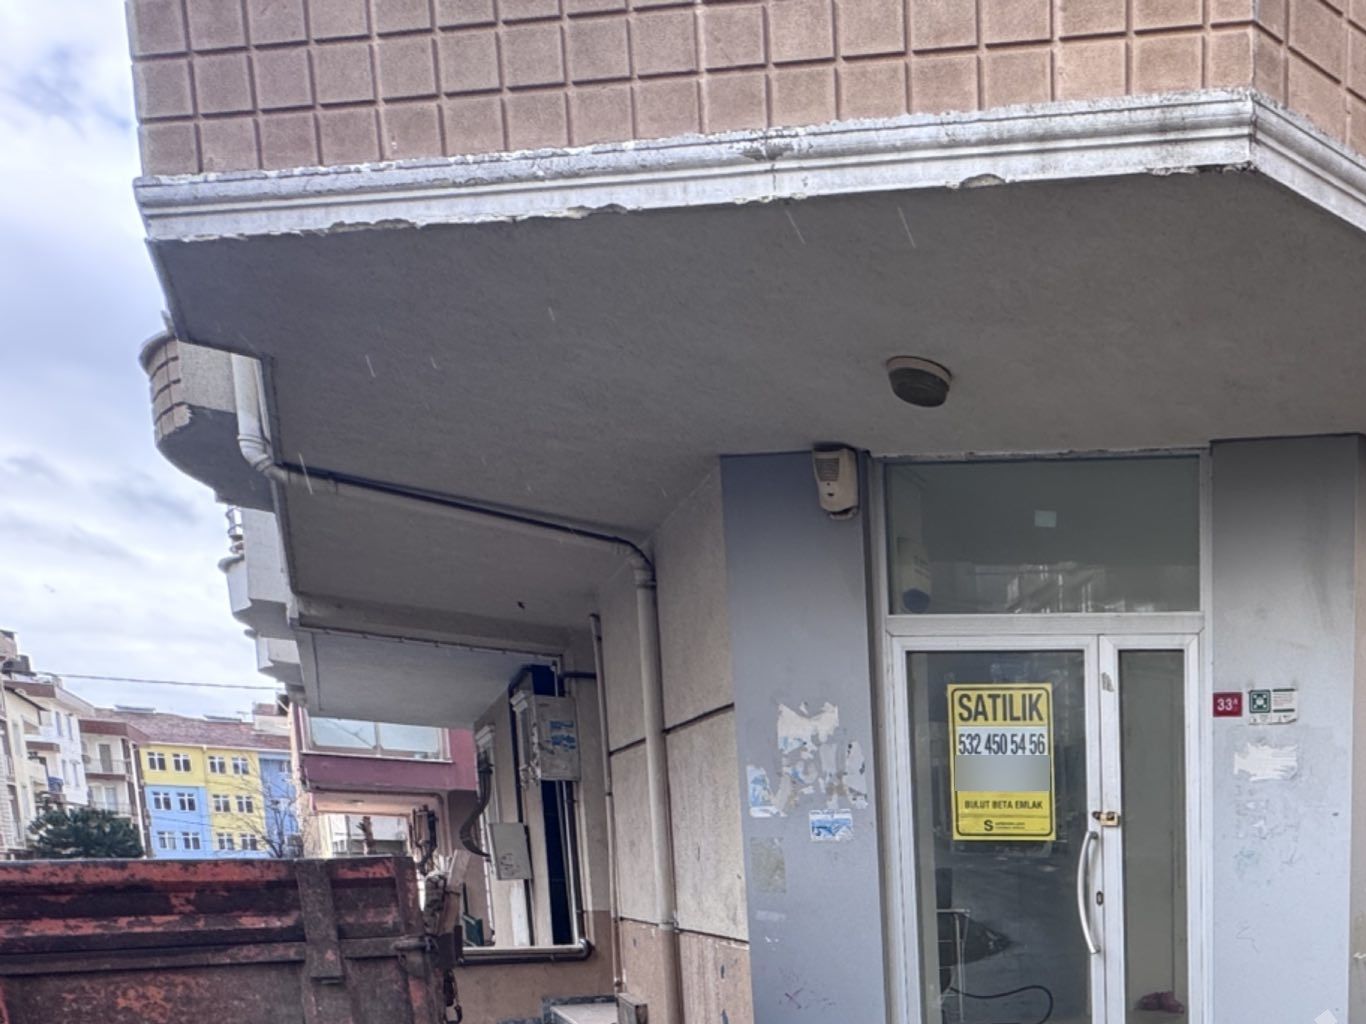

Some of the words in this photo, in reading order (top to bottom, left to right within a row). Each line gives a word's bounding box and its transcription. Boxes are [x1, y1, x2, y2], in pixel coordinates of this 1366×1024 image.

[958, 693, 1043, 722] SATILIK
[958, 734, 981, 755] 532
[984, 734, 1008, 755] 450
[1010, 734, 1026, 755] 54
[1029, 733, 1045, 755] 56
[964, 800, 990, 810] BULUT
[992, 800, 1013, 810] BETA
[1015, 800, 1043, 810] EMLAK
